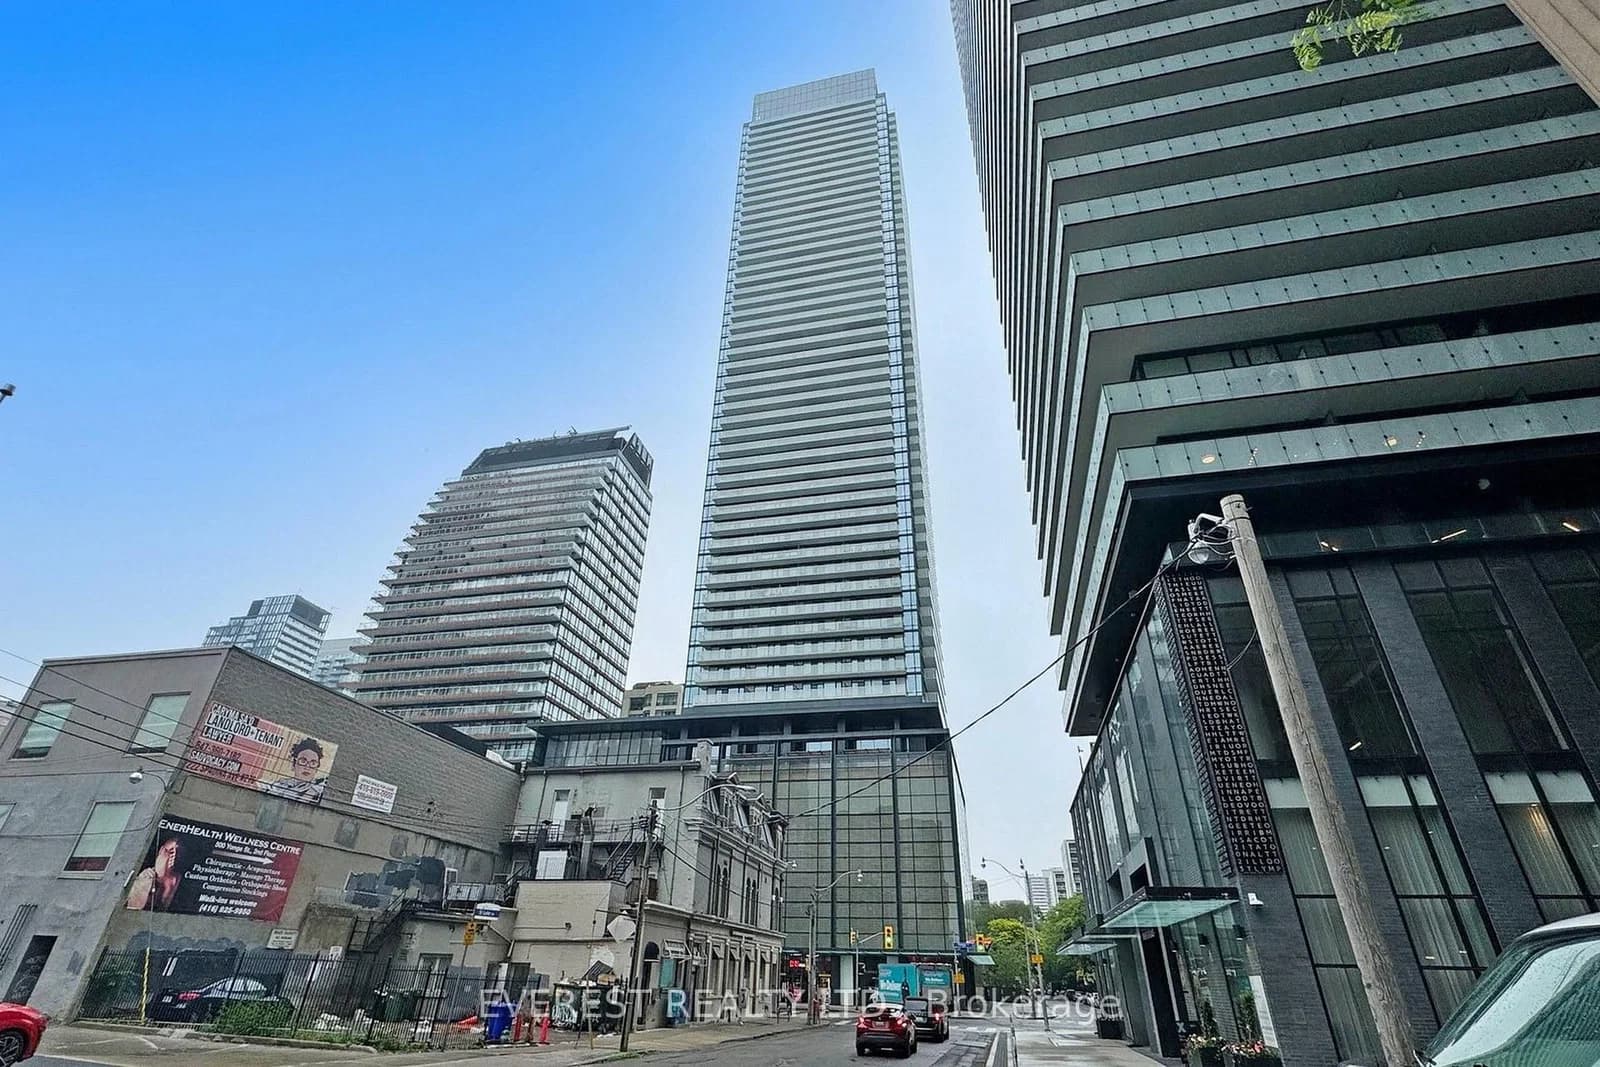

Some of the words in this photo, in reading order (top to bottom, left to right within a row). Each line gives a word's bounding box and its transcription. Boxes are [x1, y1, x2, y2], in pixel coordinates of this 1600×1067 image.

[202, 726, 233, 745] LAWYER
[225, 832, 269, 849] WELLNESS
[270, 841, 301, 855] CENTRE
[205, 857, 243, 869] Chiropractic
[192, 864, 236, 877] Physiotherapy
[184, 871, 208, 881] Custom
[209, 875, 237, 885] Orthotics
[241, 879, 271, 891] Orthopedic
[202, 882, 241, 894] Compression
[199, 894, 228, 905] Walk-ins
[229, 897, 258, 908] welcome
[199, 903, 219, 914] (416)
